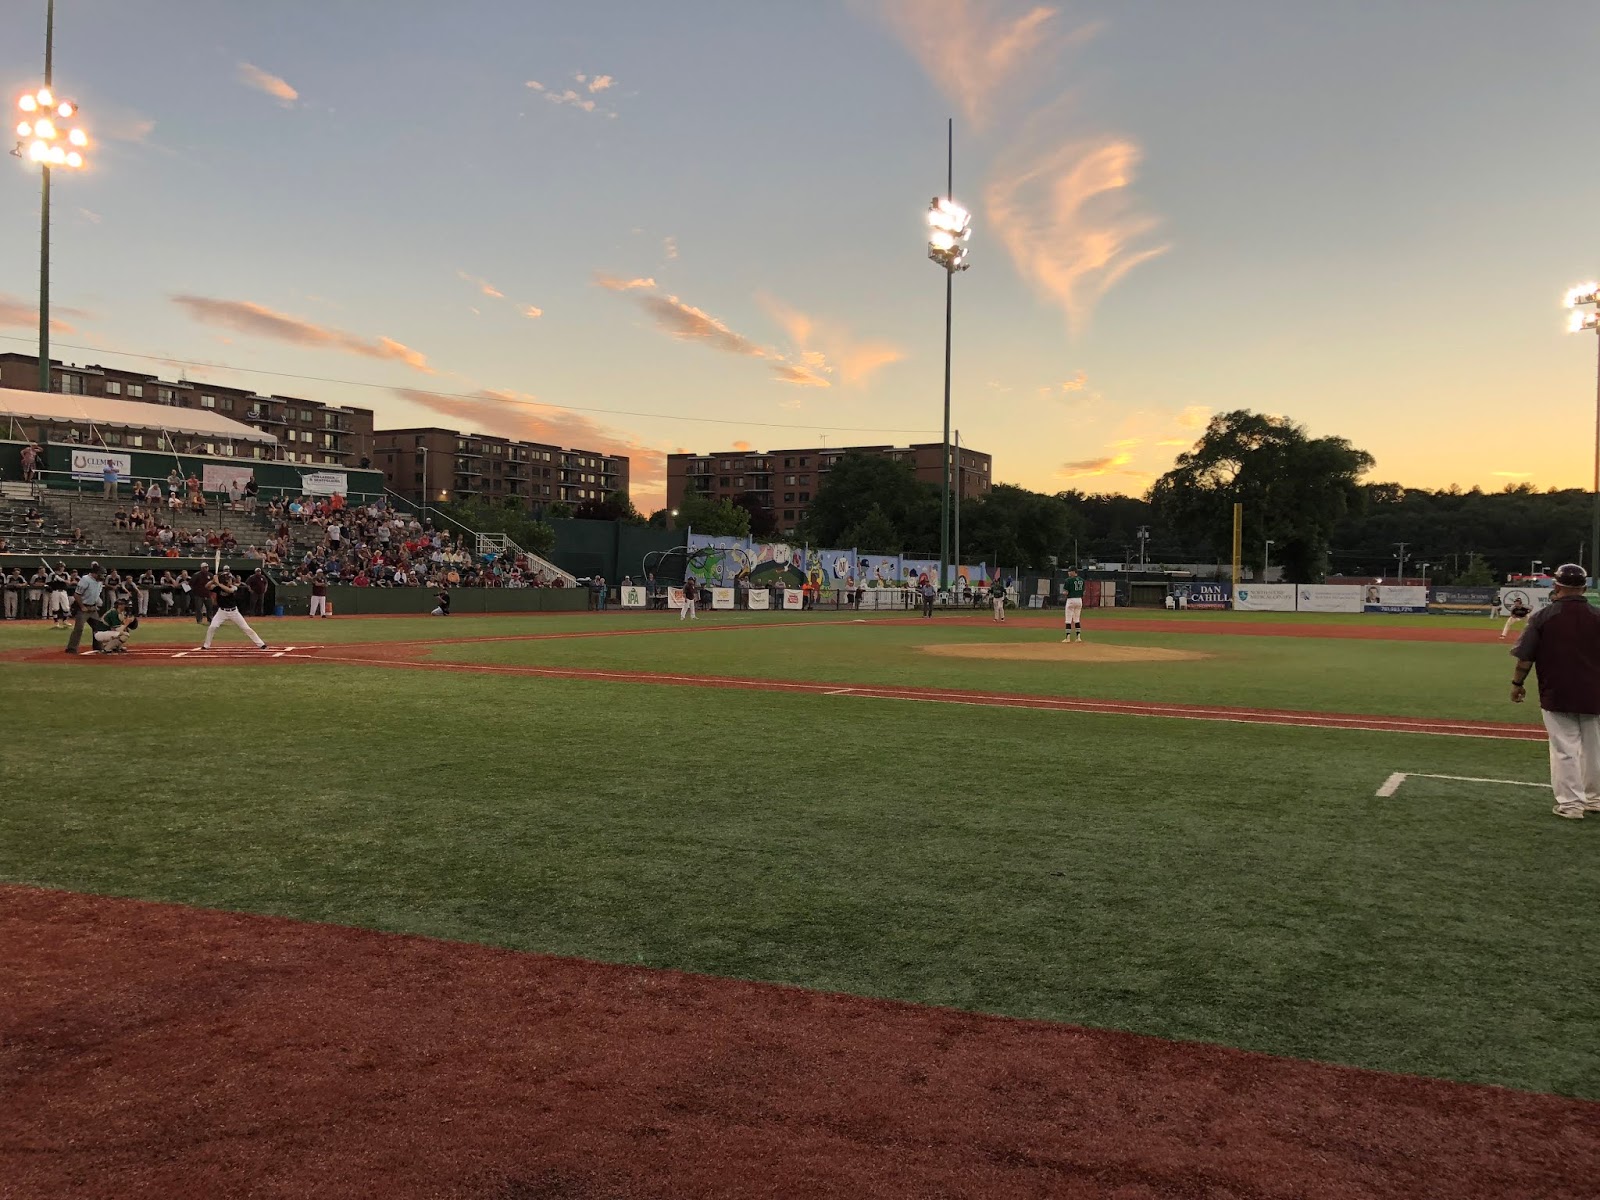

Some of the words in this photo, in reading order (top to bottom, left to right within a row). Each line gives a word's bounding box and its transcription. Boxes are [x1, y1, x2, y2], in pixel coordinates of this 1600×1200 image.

[87, 457, 124, 468] CLEMNTS
[1074, 581, 1083, 591] 17
[1200, 585, 1221, 594] DAN
[1191, 594, 1230, 602] CAHILL
